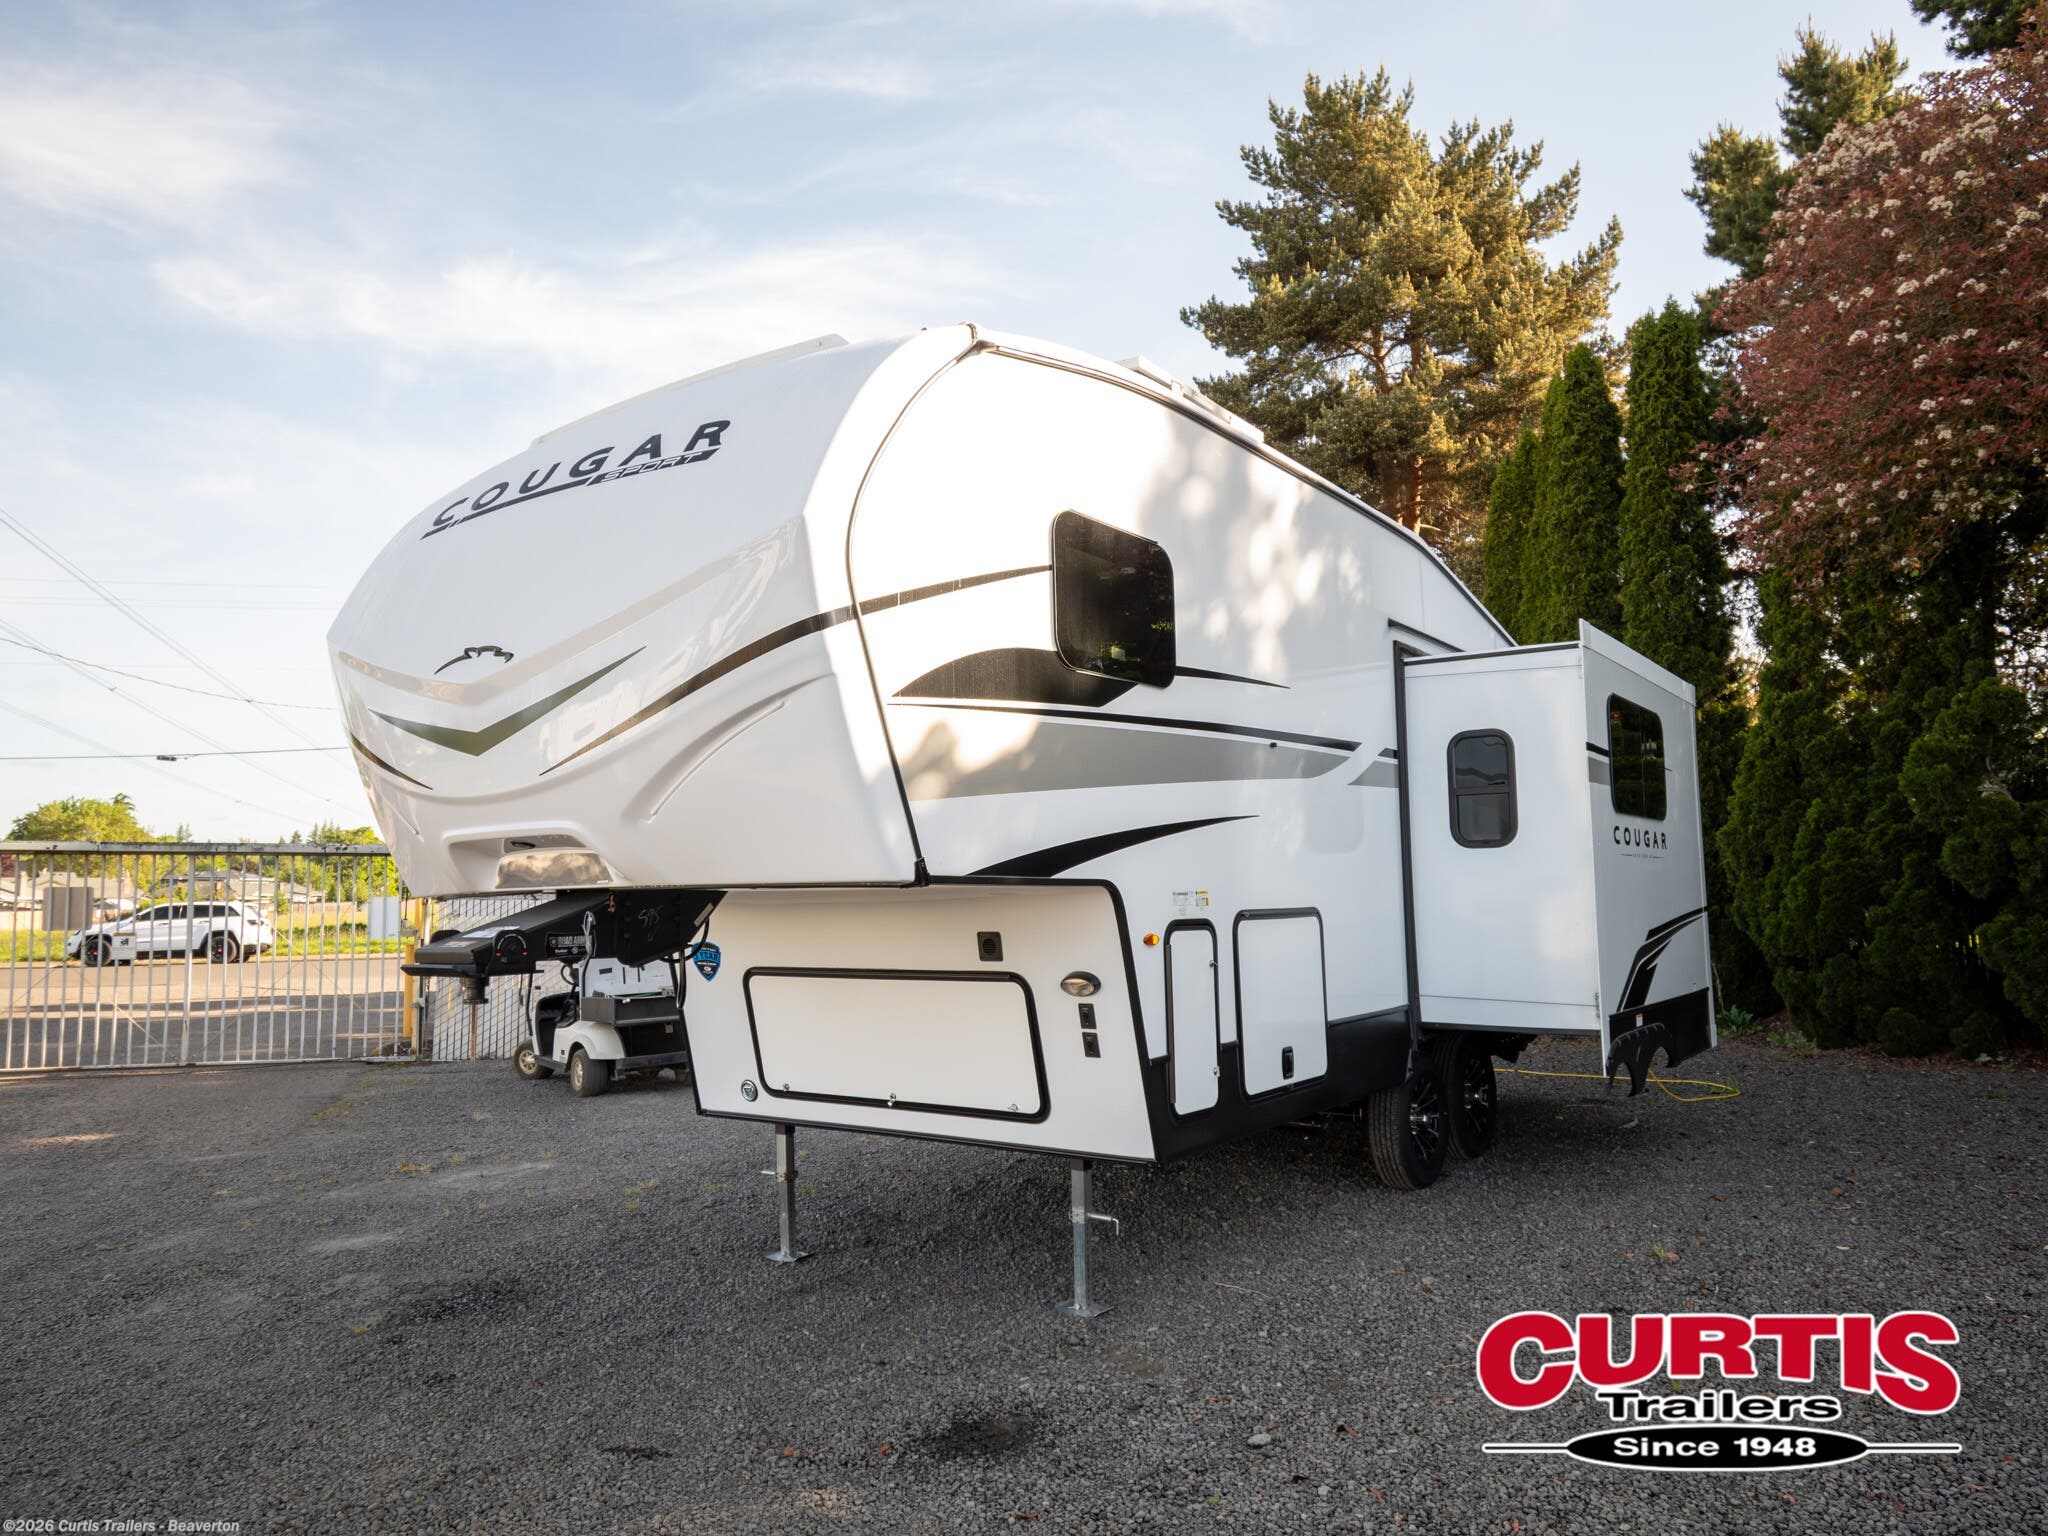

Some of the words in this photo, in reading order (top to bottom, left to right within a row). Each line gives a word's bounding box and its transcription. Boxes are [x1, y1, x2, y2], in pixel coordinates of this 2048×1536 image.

[433, 420, 731, 527] COUGAR
[603, 451, 703, 480] SPORT
[1613, 825, 1668, 850] COUGAR
